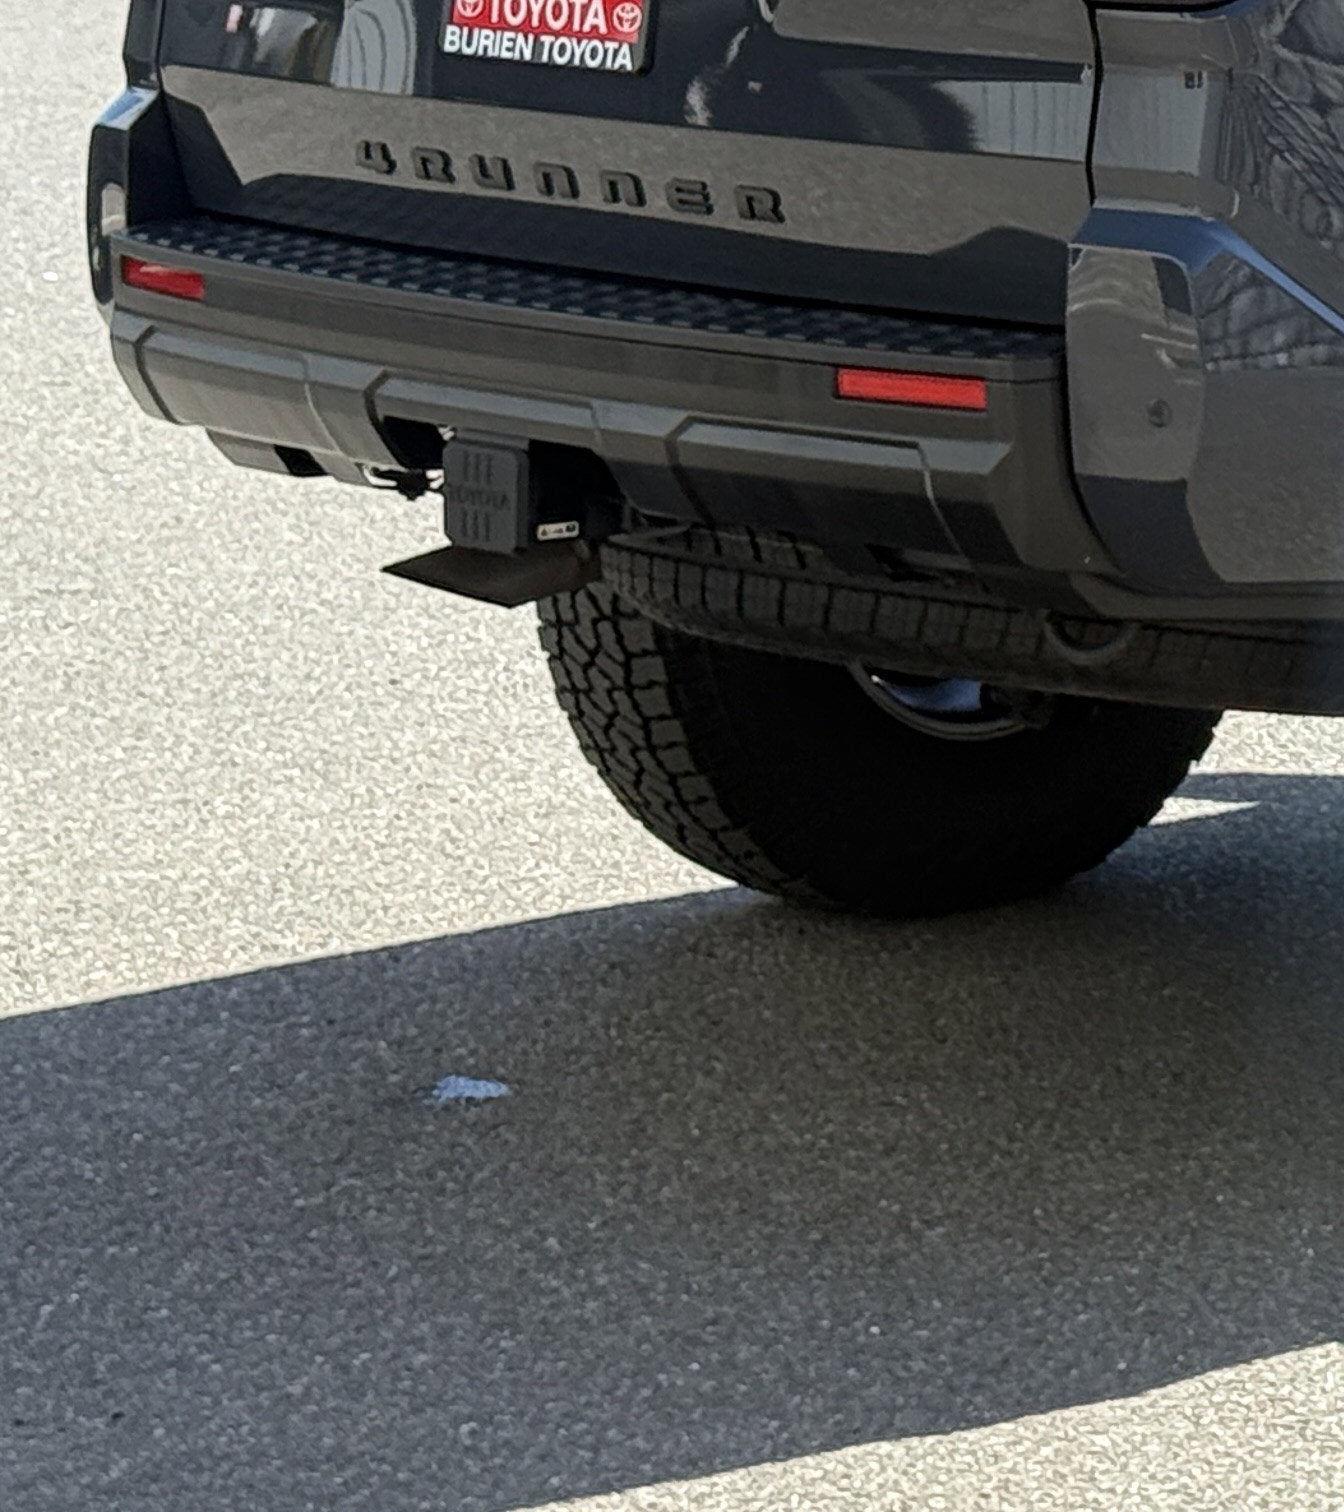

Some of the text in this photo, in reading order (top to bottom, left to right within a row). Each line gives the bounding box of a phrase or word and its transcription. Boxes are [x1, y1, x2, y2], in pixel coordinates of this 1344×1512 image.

[443, 24, 634, 72] BURIEN TOYOTA
[355, 139, 787, 225] 4RUNNER
